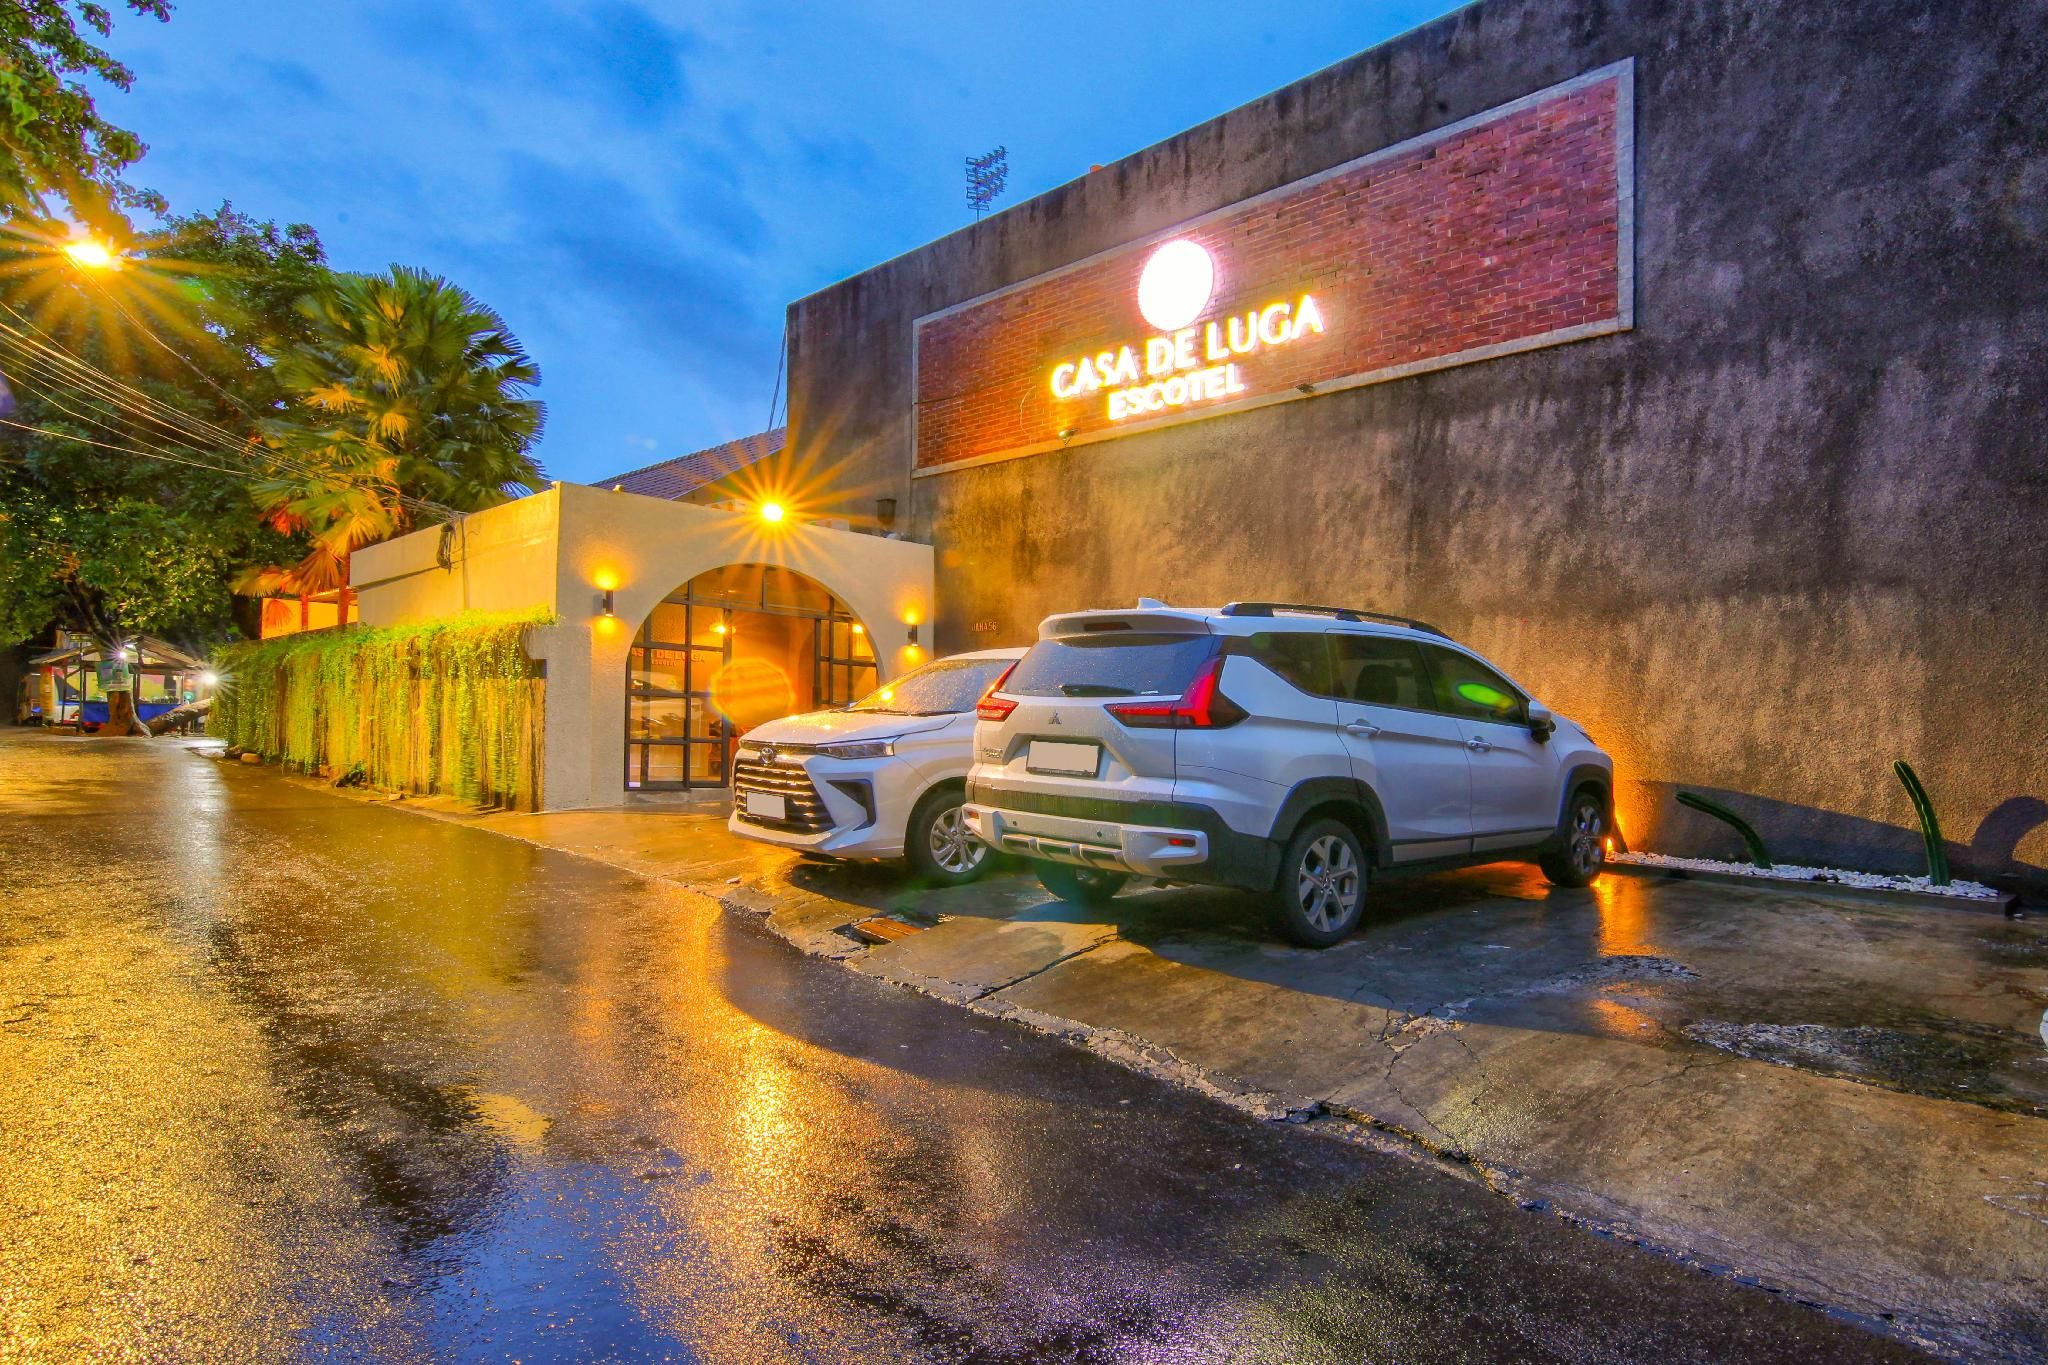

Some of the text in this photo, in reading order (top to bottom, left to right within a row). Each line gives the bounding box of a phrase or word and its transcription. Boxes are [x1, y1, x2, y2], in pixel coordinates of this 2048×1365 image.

[1050, 294, 1325, 399] CASA DE LUGA
[1108, 362, 1245, 421] ESCOTEL
